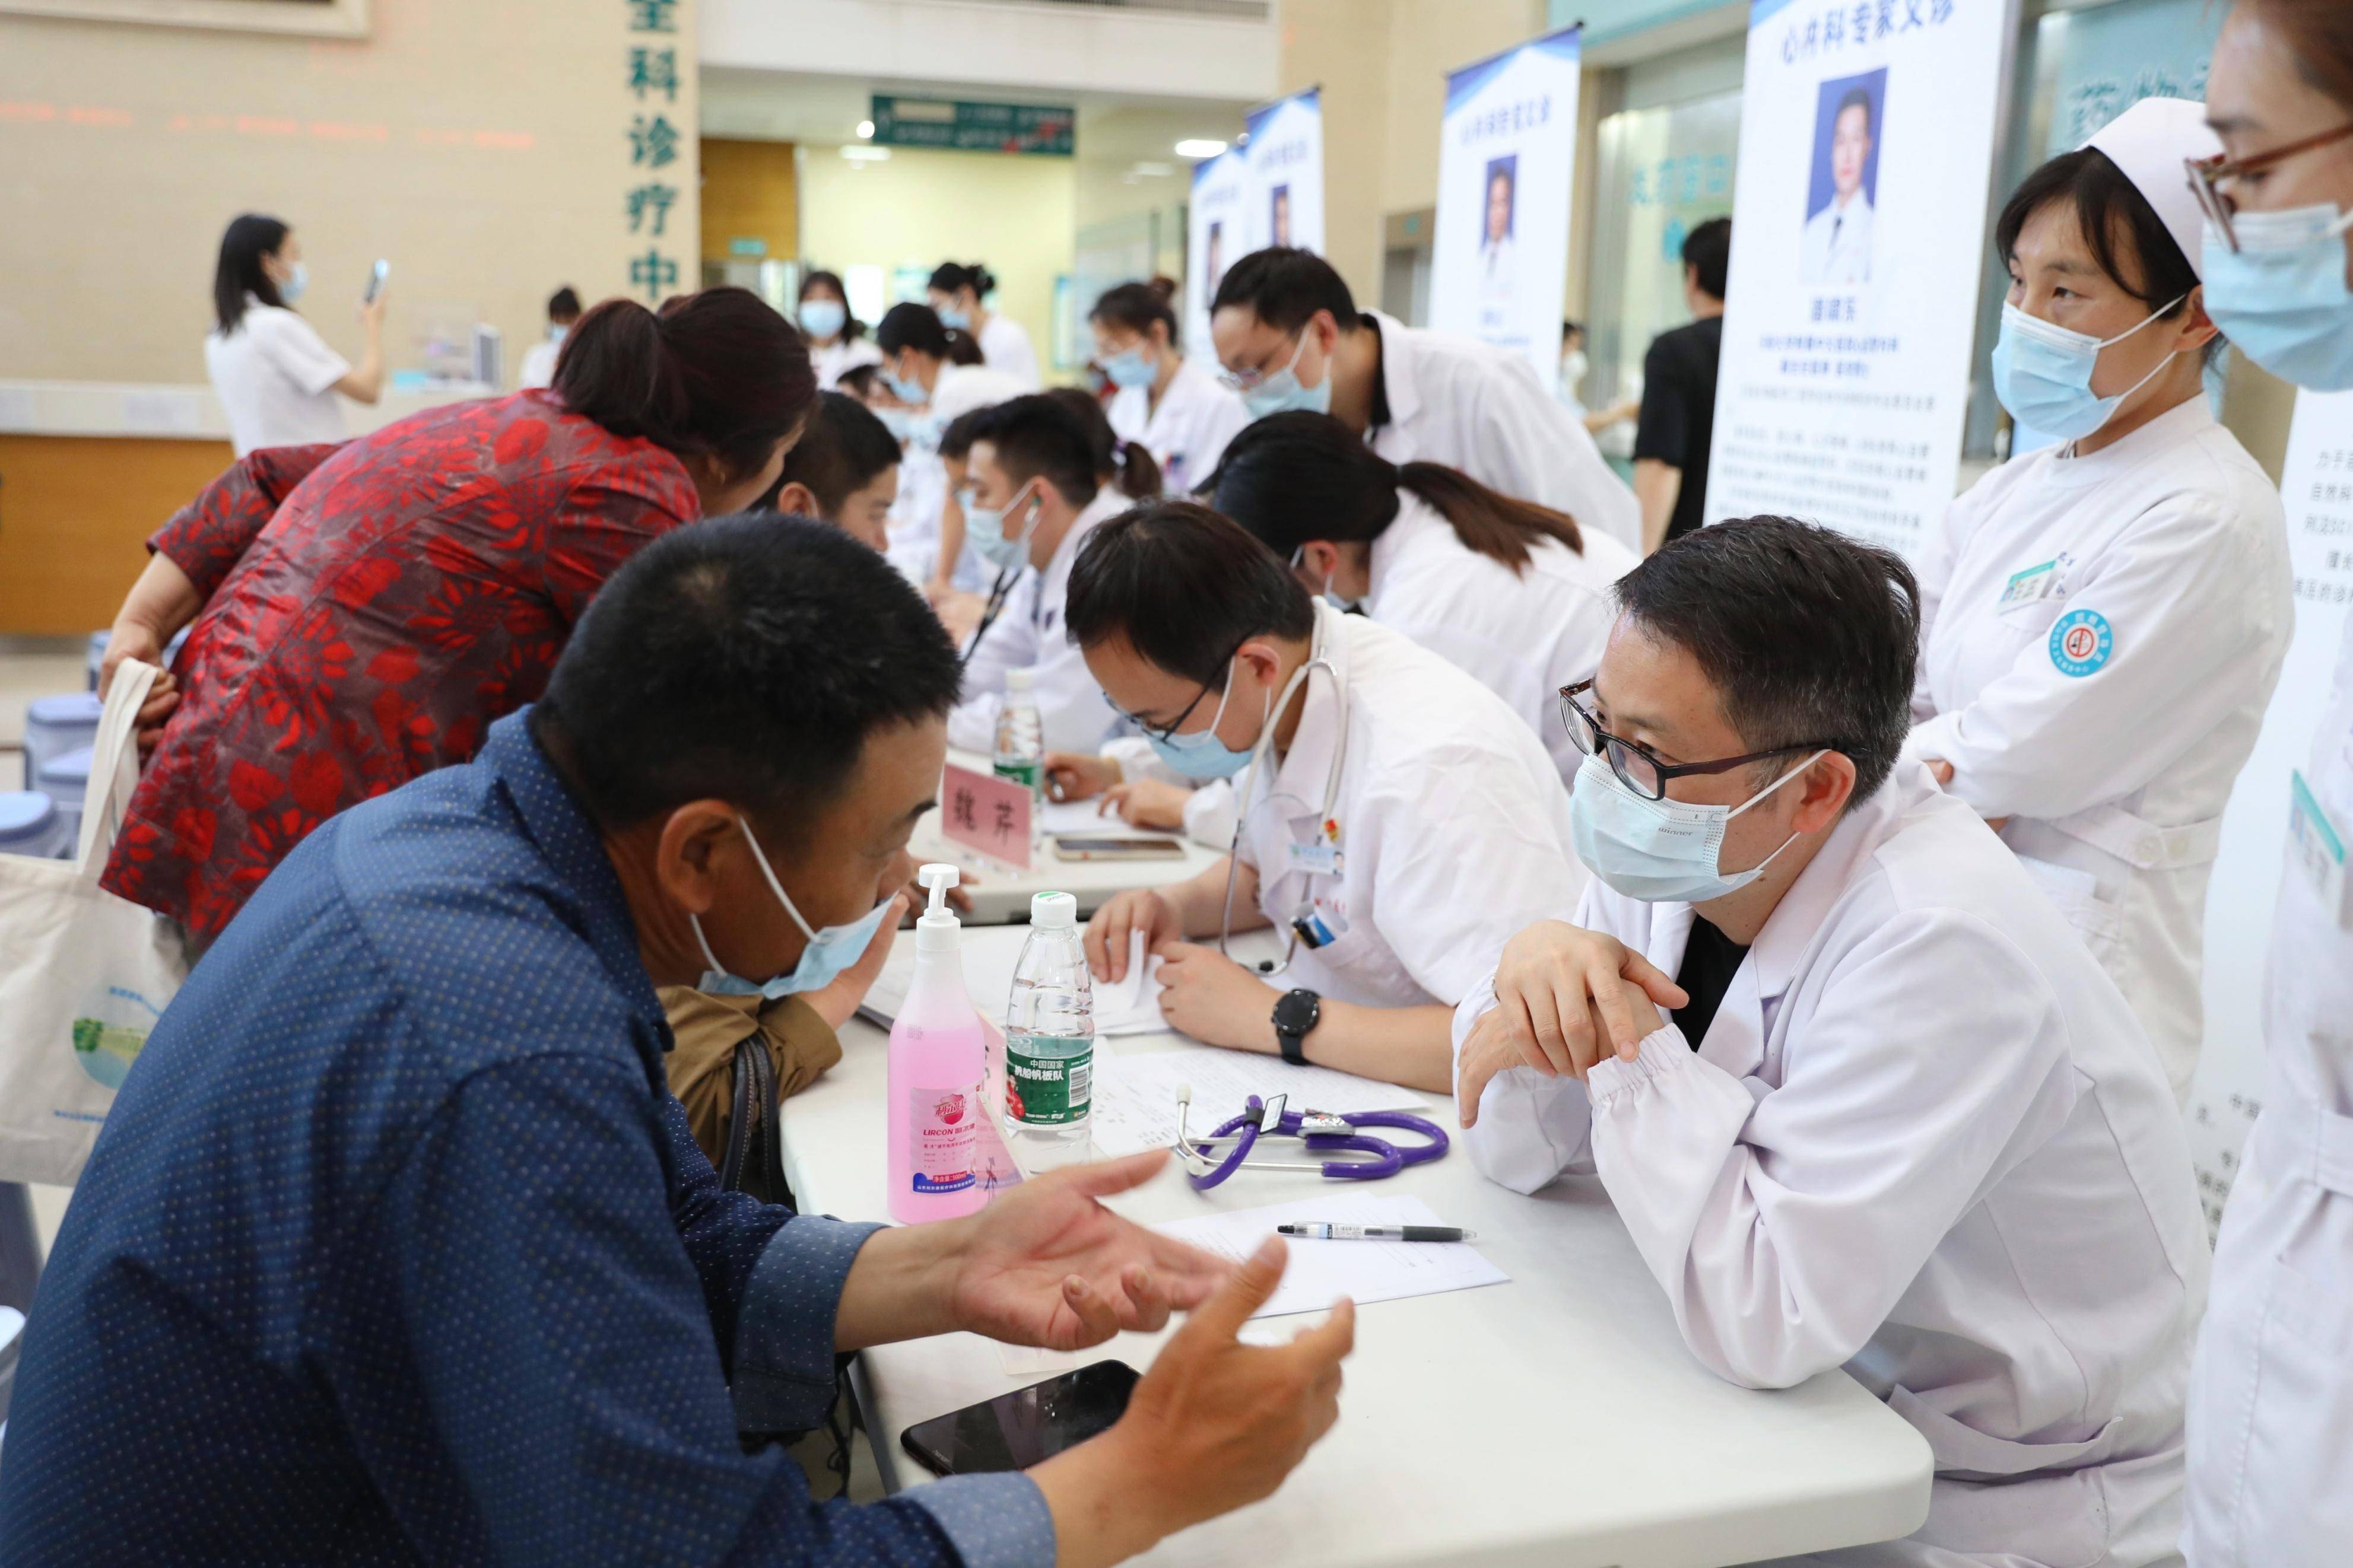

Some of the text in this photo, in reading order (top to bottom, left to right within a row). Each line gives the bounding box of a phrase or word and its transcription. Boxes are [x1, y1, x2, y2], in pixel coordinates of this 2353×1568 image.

[1658, 827, 1693, 837] winner
[1030, 1060, 1065, 1069] 中国国家
[1014, 1064, 1064, 1081] 帆船帆板队
